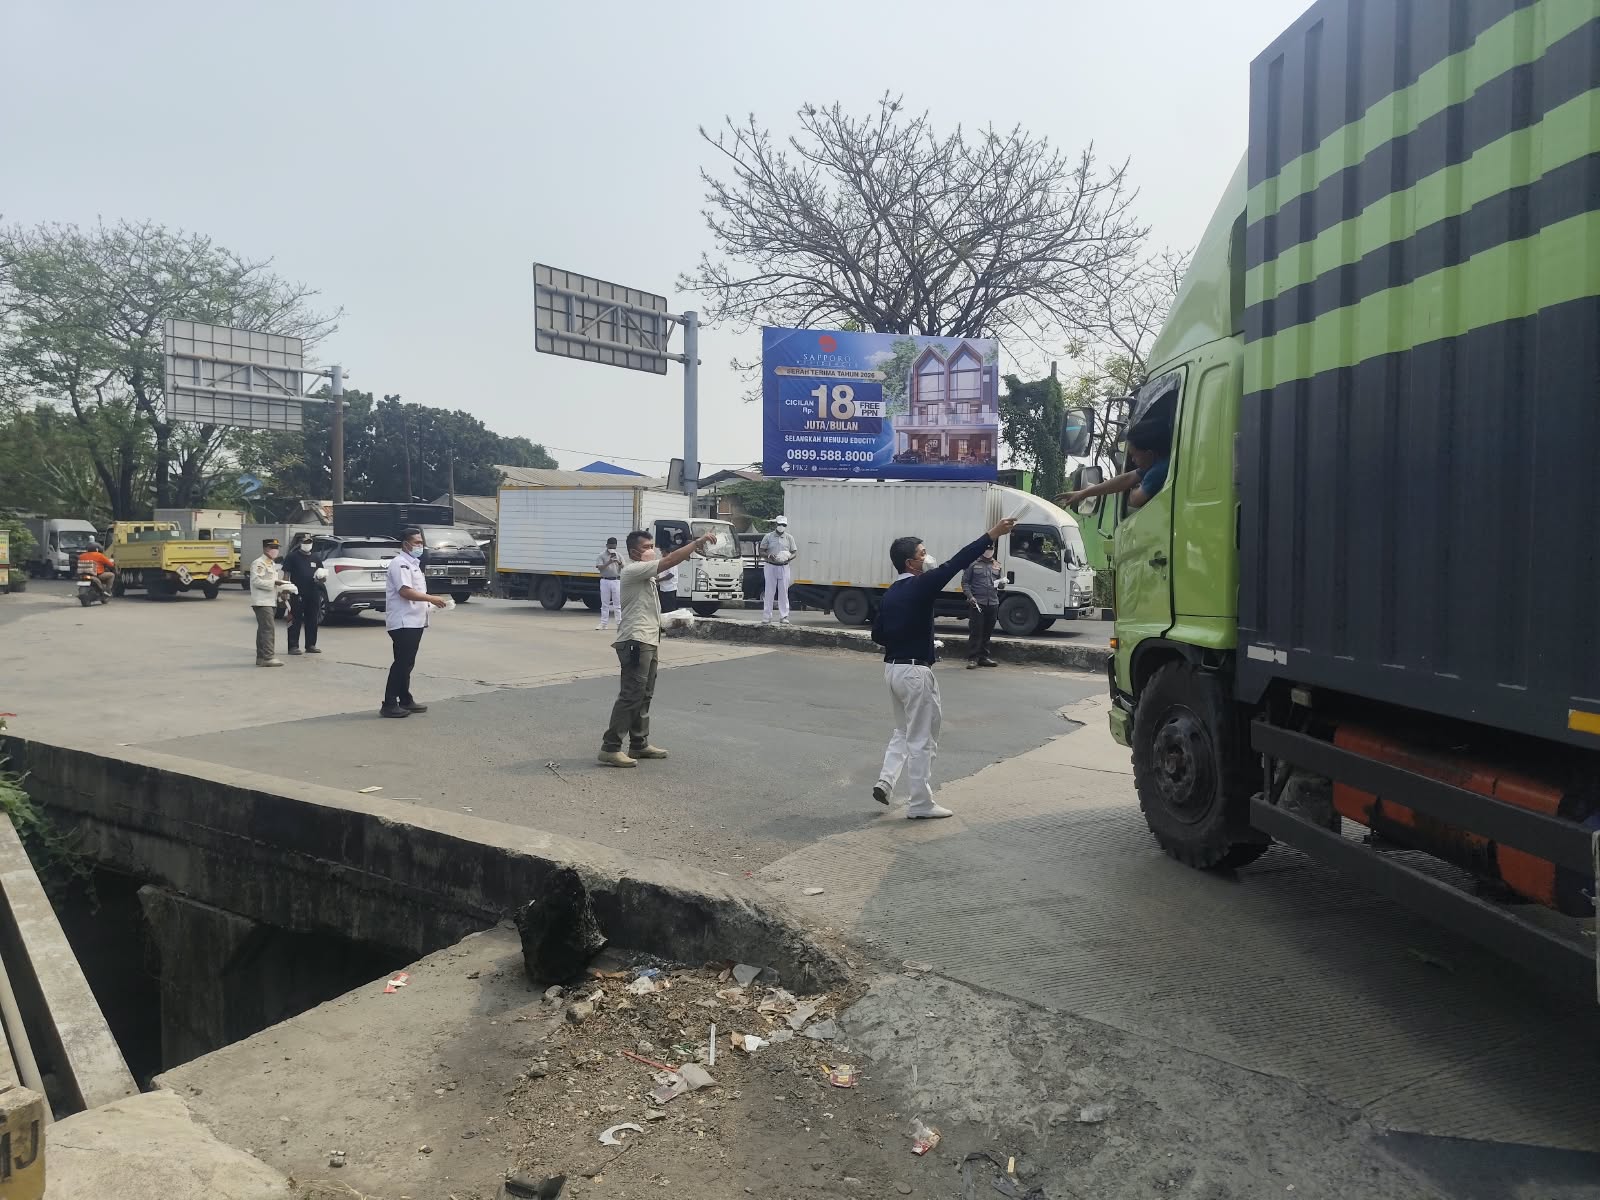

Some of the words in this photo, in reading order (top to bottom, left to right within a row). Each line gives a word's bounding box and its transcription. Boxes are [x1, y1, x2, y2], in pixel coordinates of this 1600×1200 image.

[803, 353, 851, 362] SAPPORO
[787, 367, 810, 375] SERAH
[811, 368, 836, 376] TERIMA
[837, 370, 860, 378] TAHUN
[785, 399, 814, 407] CICILAN
[811, 384, 855, 420] 18
[860, 402, 880, 410] FREE
[861, 409, 878, 417] PPN
[804, 420, 859, 431] JUTA/BULAN
[784, 434, 821, 443] SELANGKAH
[822, 436, 849, 444] MENUJU
[850, 437, 876, 445] EDUCITY
[786, 448, 874, 462] 0899.588.8000
